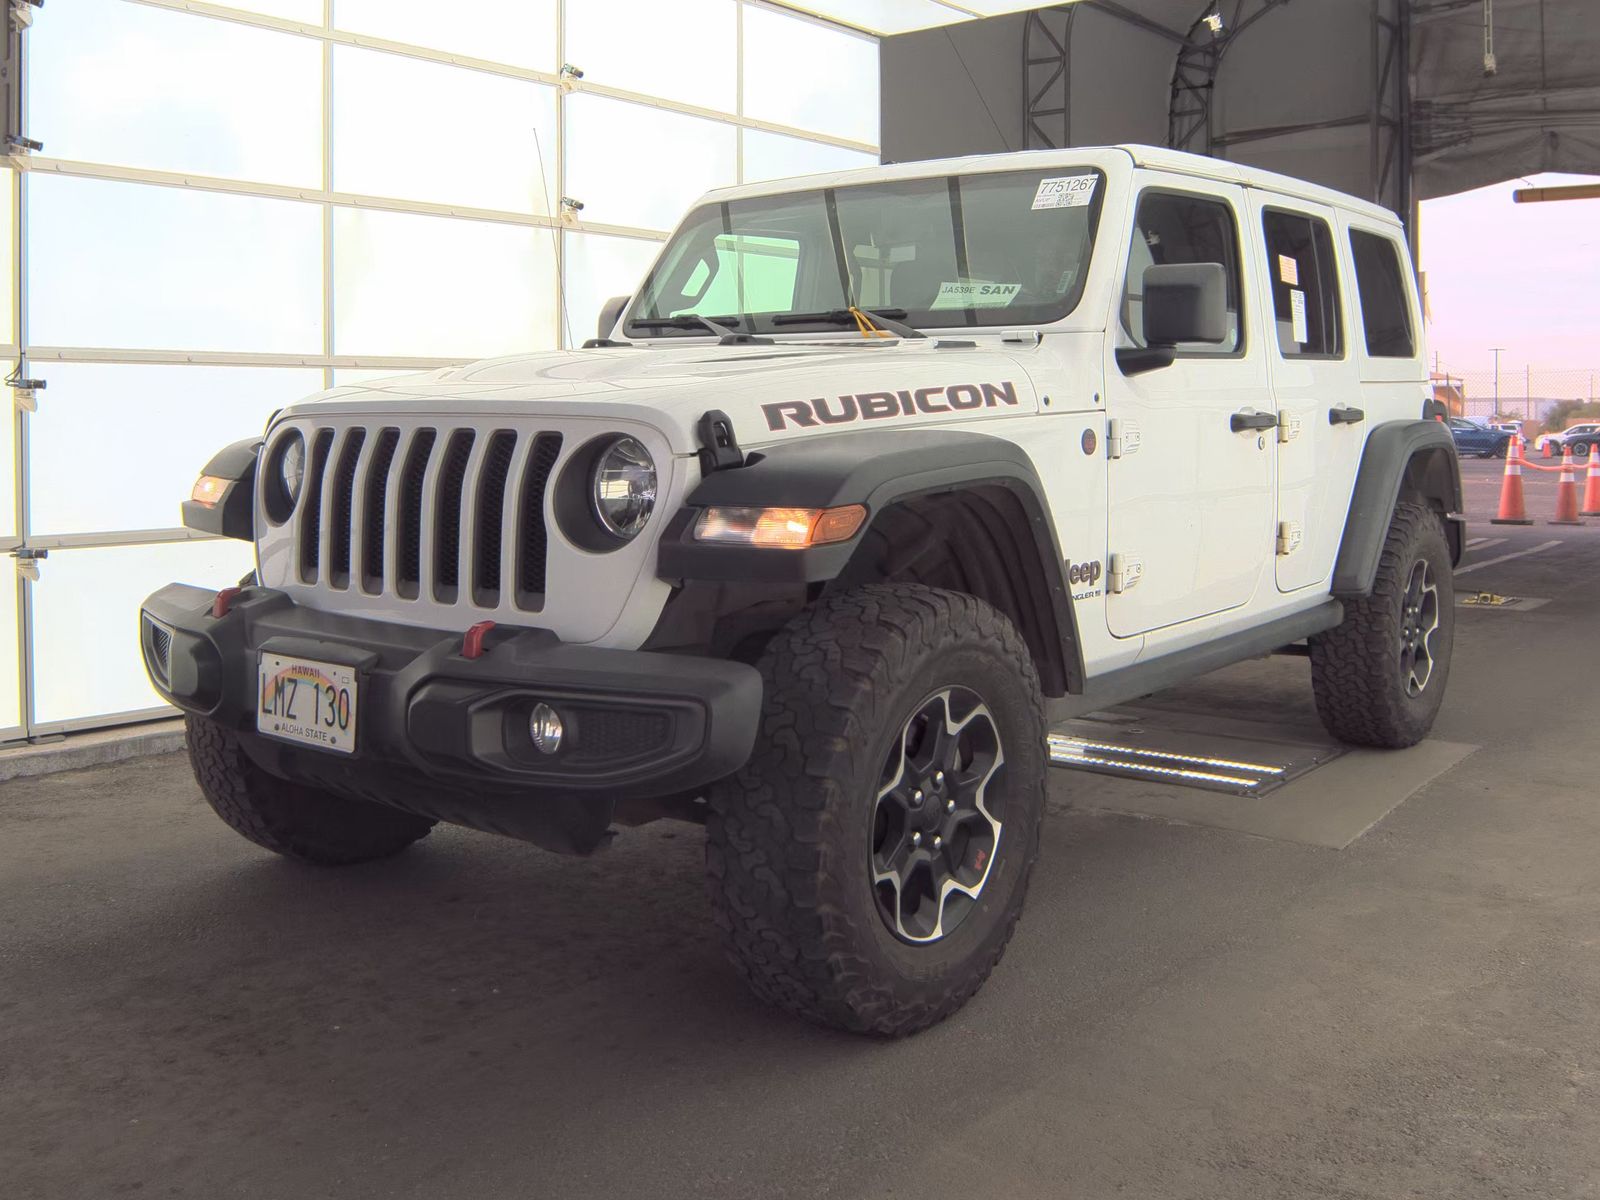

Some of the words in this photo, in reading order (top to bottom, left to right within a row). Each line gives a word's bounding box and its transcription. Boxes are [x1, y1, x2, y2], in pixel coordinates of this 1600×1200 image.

[1041, 178, 1096, 194] 7751267
[980, 285, 1015, 294] SAN
[760, 381, 1018, 431] RUBICON
[1072, 590, 1094, 601] NGLER
[292, 664, 320, 678] HAWAII
[262, 673, 297, 720] LMZ
[314, 683, 350, 730] 130
[281, 723, 303, 736] ALOHA
[305, 728, 327, 742] STATE
